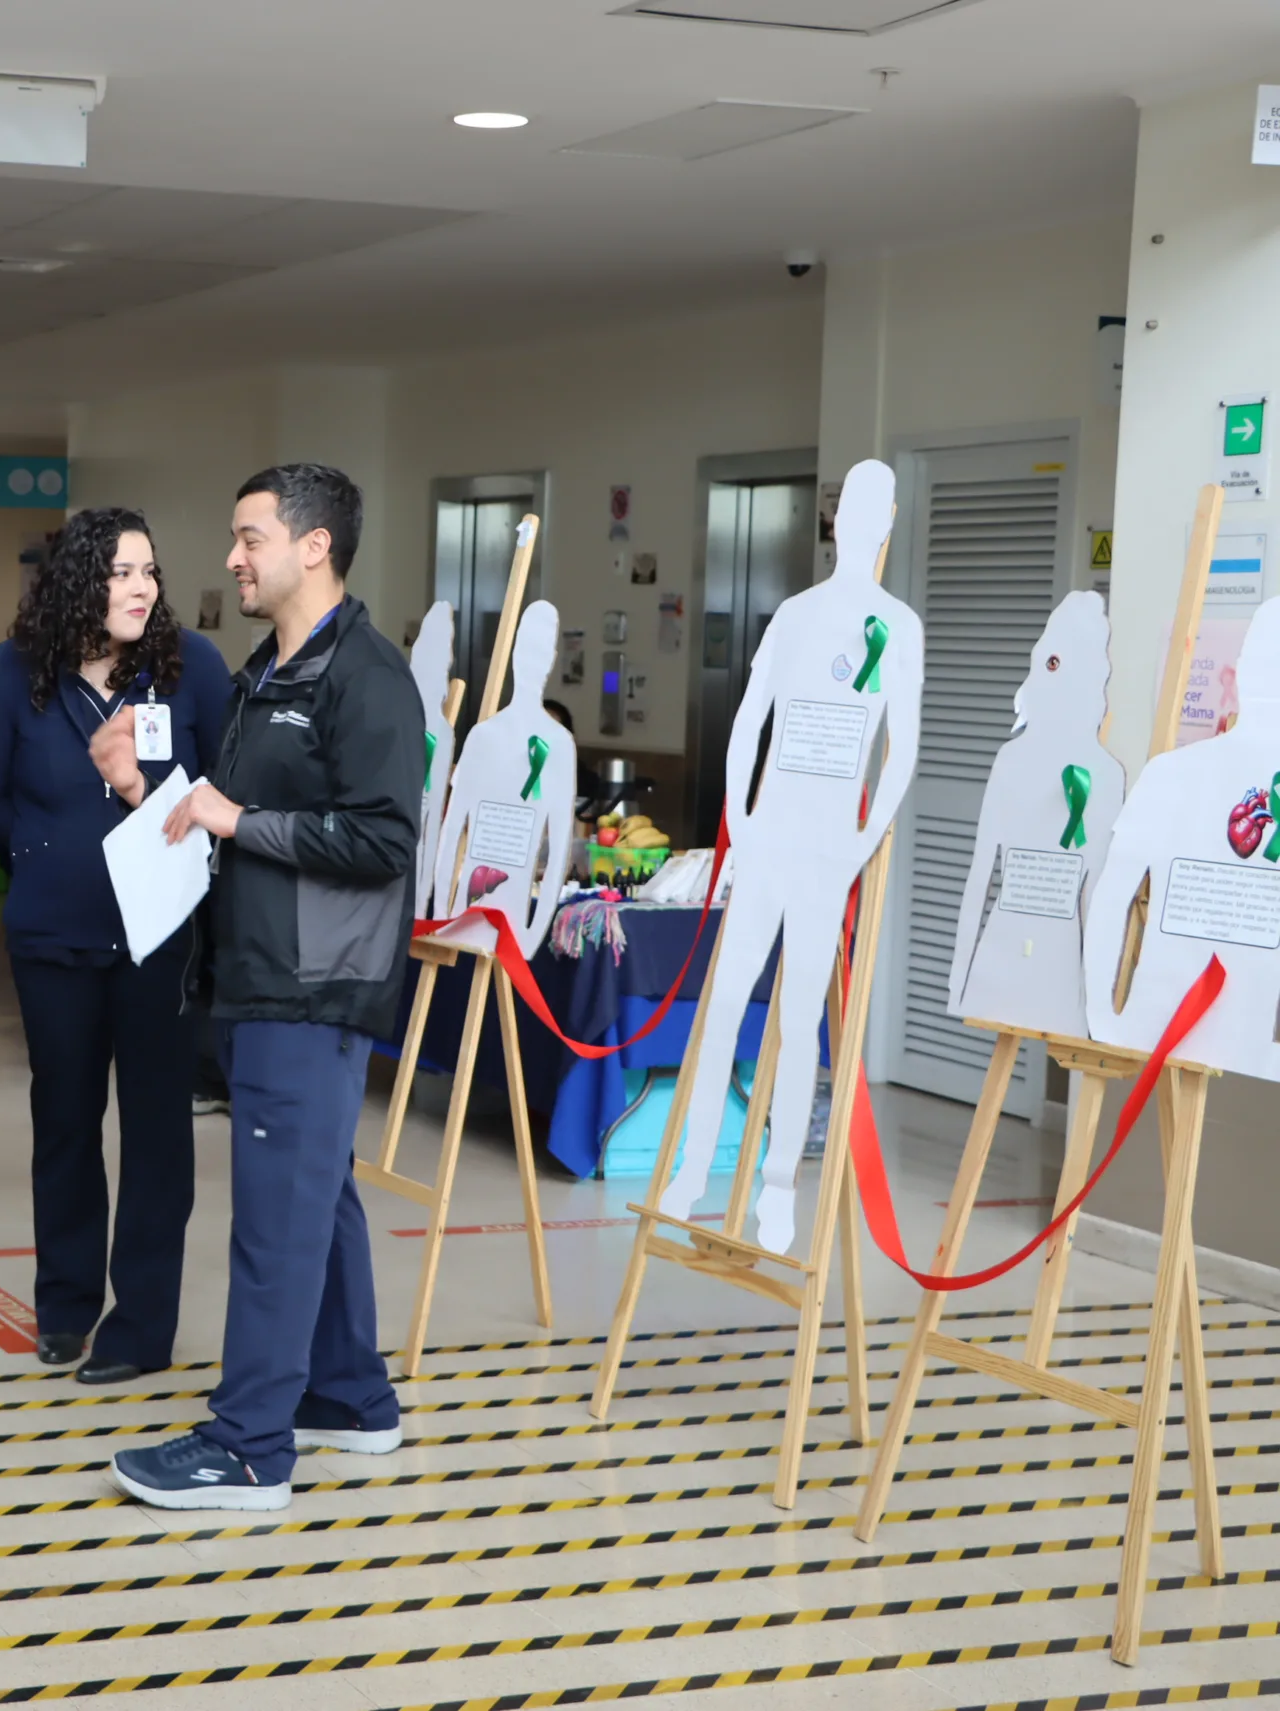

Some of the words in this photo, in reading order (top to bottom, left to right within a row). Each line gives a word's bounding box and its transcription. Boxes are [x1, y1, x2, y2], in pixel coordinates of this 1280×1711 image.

[1260, 119, 1271, 129] DE
[1259, 132, 1271, 142] DE
[1184, 690, 1202, 702] cer
[1180, 705, 1214, 720] Mama
